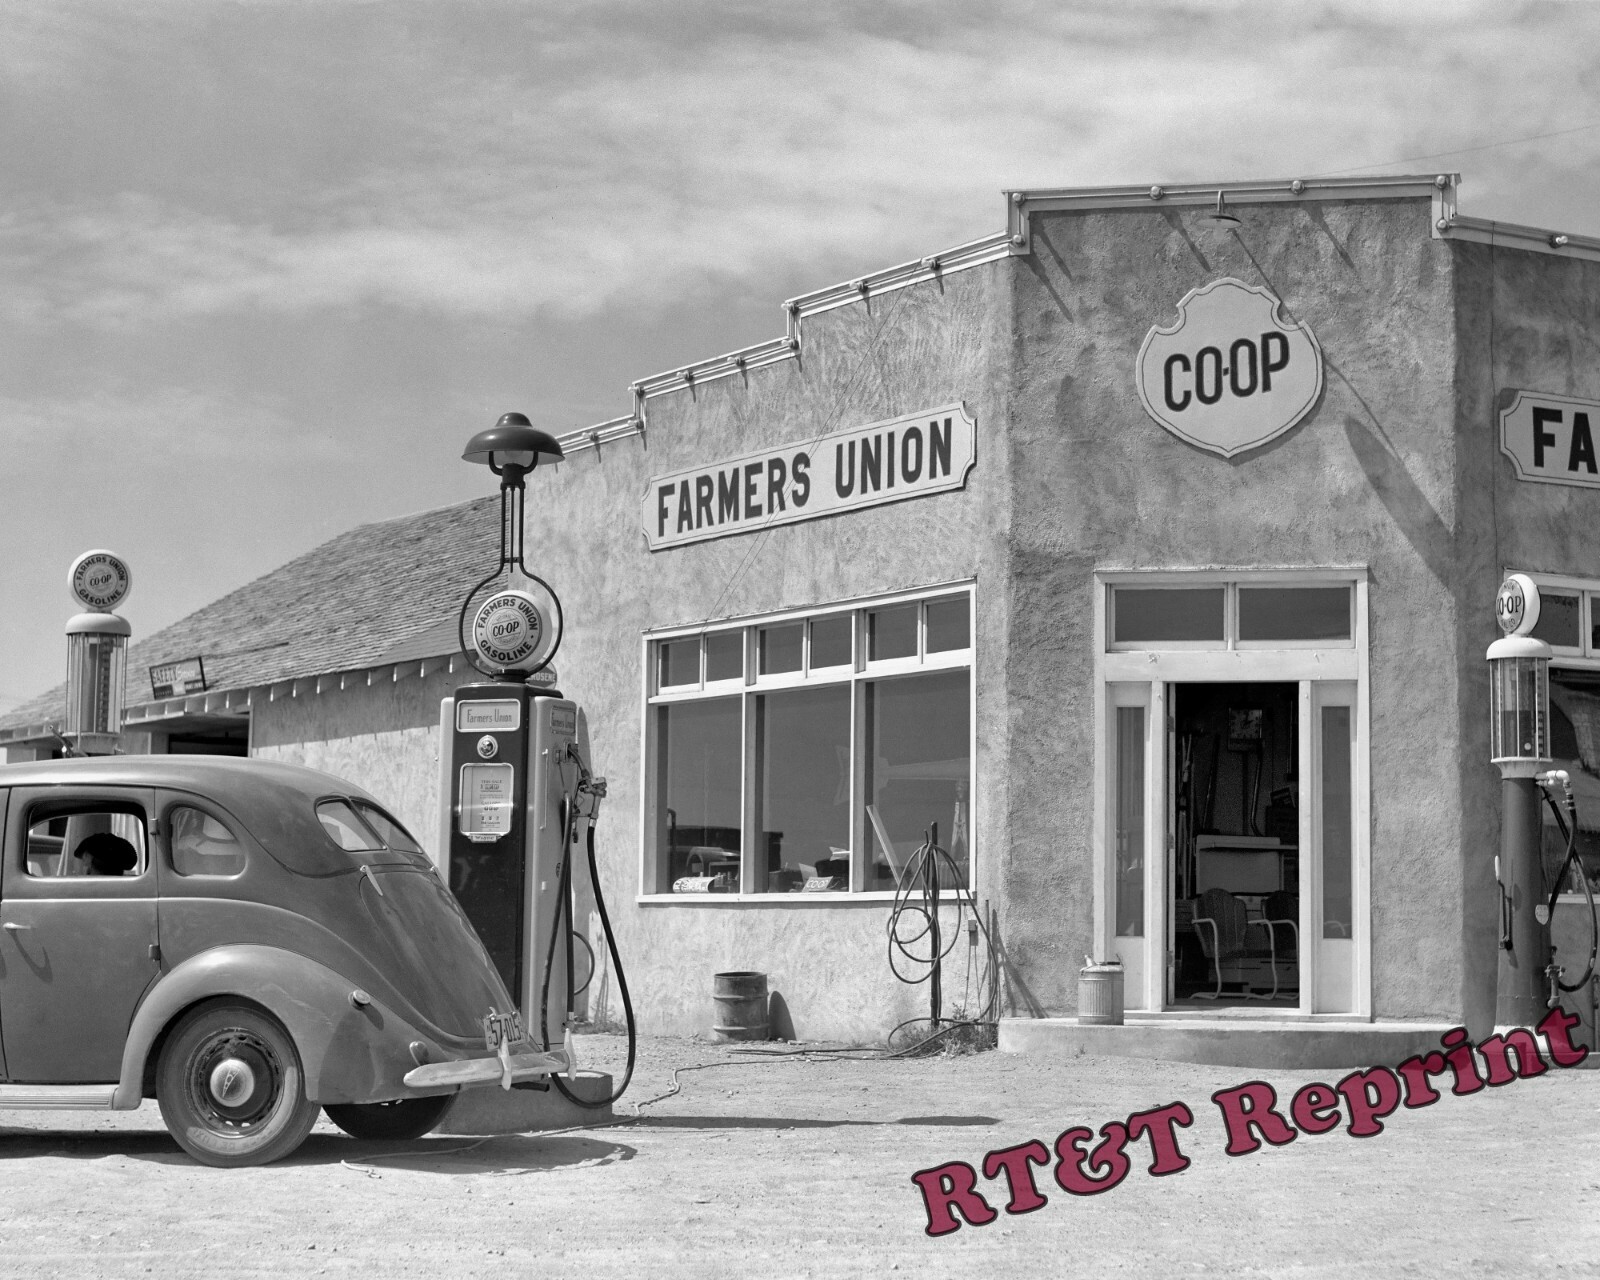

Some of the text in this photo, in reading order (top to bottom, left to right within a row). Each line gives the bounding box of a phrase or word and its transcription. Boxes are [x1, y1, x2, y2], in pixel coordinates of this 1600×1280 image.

[1163, 331, 1290, 412] CO-OP
[1532, 406, 1599, 475] FA
[658, 417, 952, 538] FARMERS UNION
[77, 556, 125, 581] FARMERS UNION
[79, 589, 121, 605] GASOLINE
[478, 598, 538, 630] FARMERS UNION
[492, 621, 519, 637] CO-OP
[480, 640, 532, 661] GASOLINE
[467, 708, 513, 723] Farmers Union
